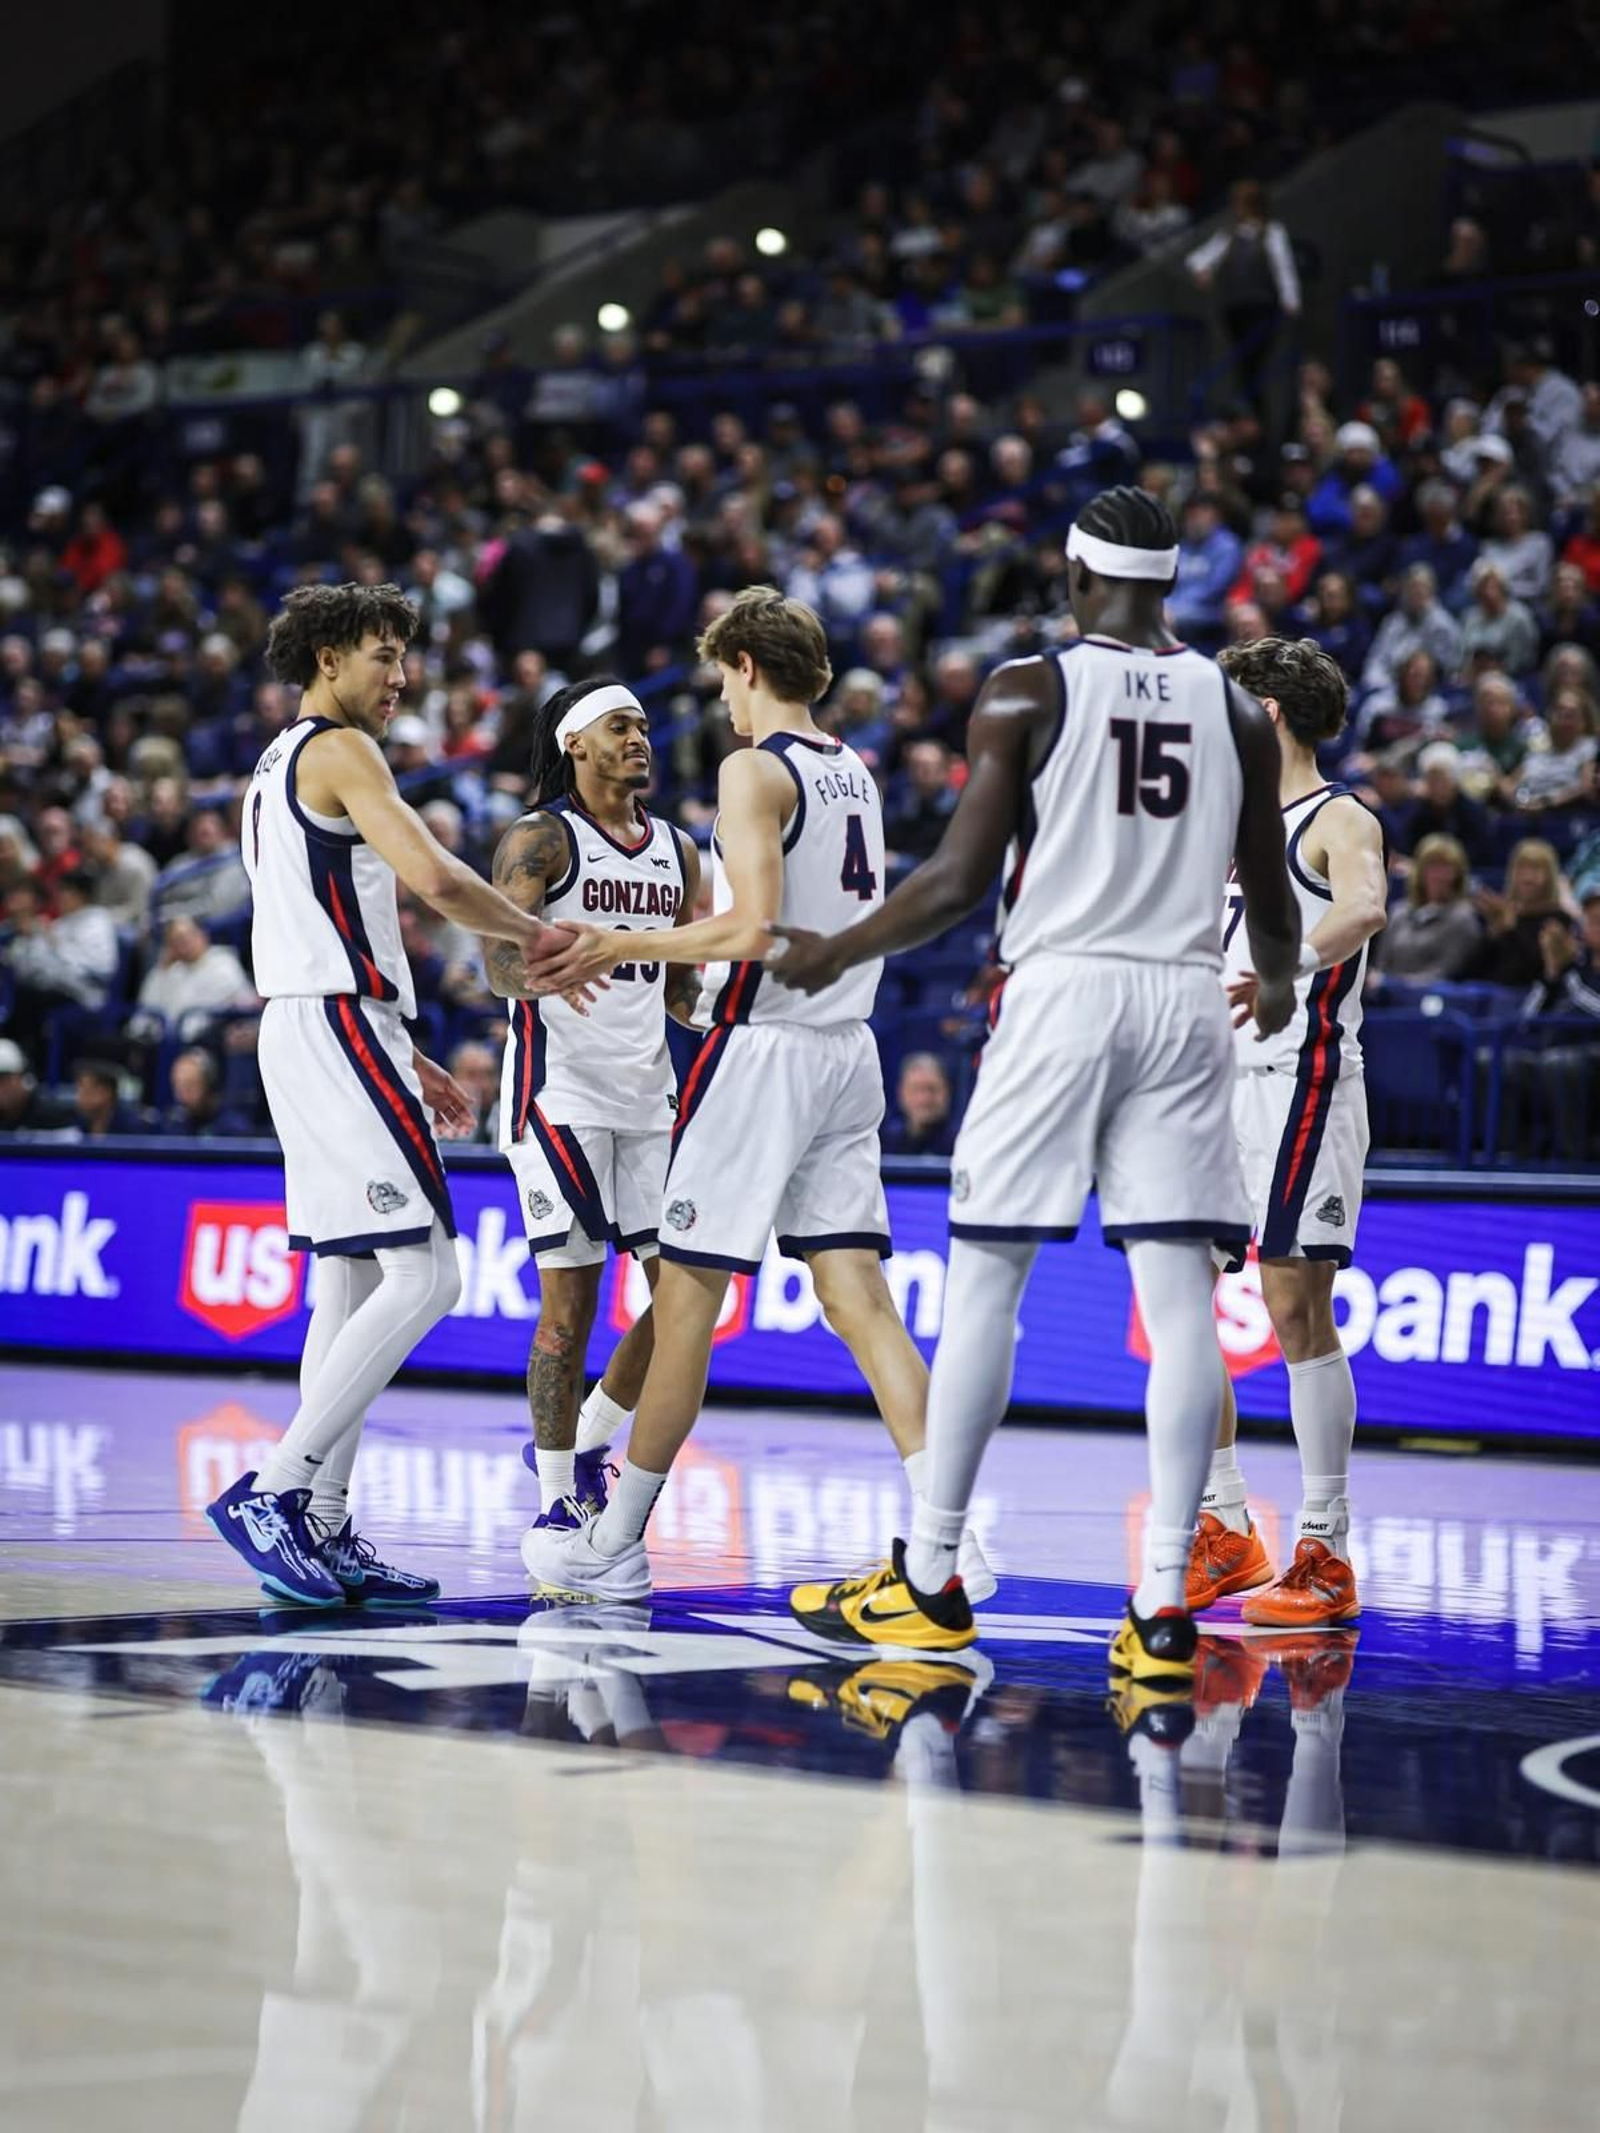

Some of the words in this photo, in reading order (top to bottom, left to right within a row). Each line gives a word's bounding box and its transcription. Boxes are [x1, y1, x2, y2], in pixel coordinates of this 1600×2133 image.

[1125, 670, 1171, 701] IKE
[815, 772, 870, 806] FOGLE
[1109, 717, 1192, 819] 15
[840, 814, 877, 901] 4
[582, 877, 681, 918] GONZAGA
[190, 1223, 294, 1310] us
